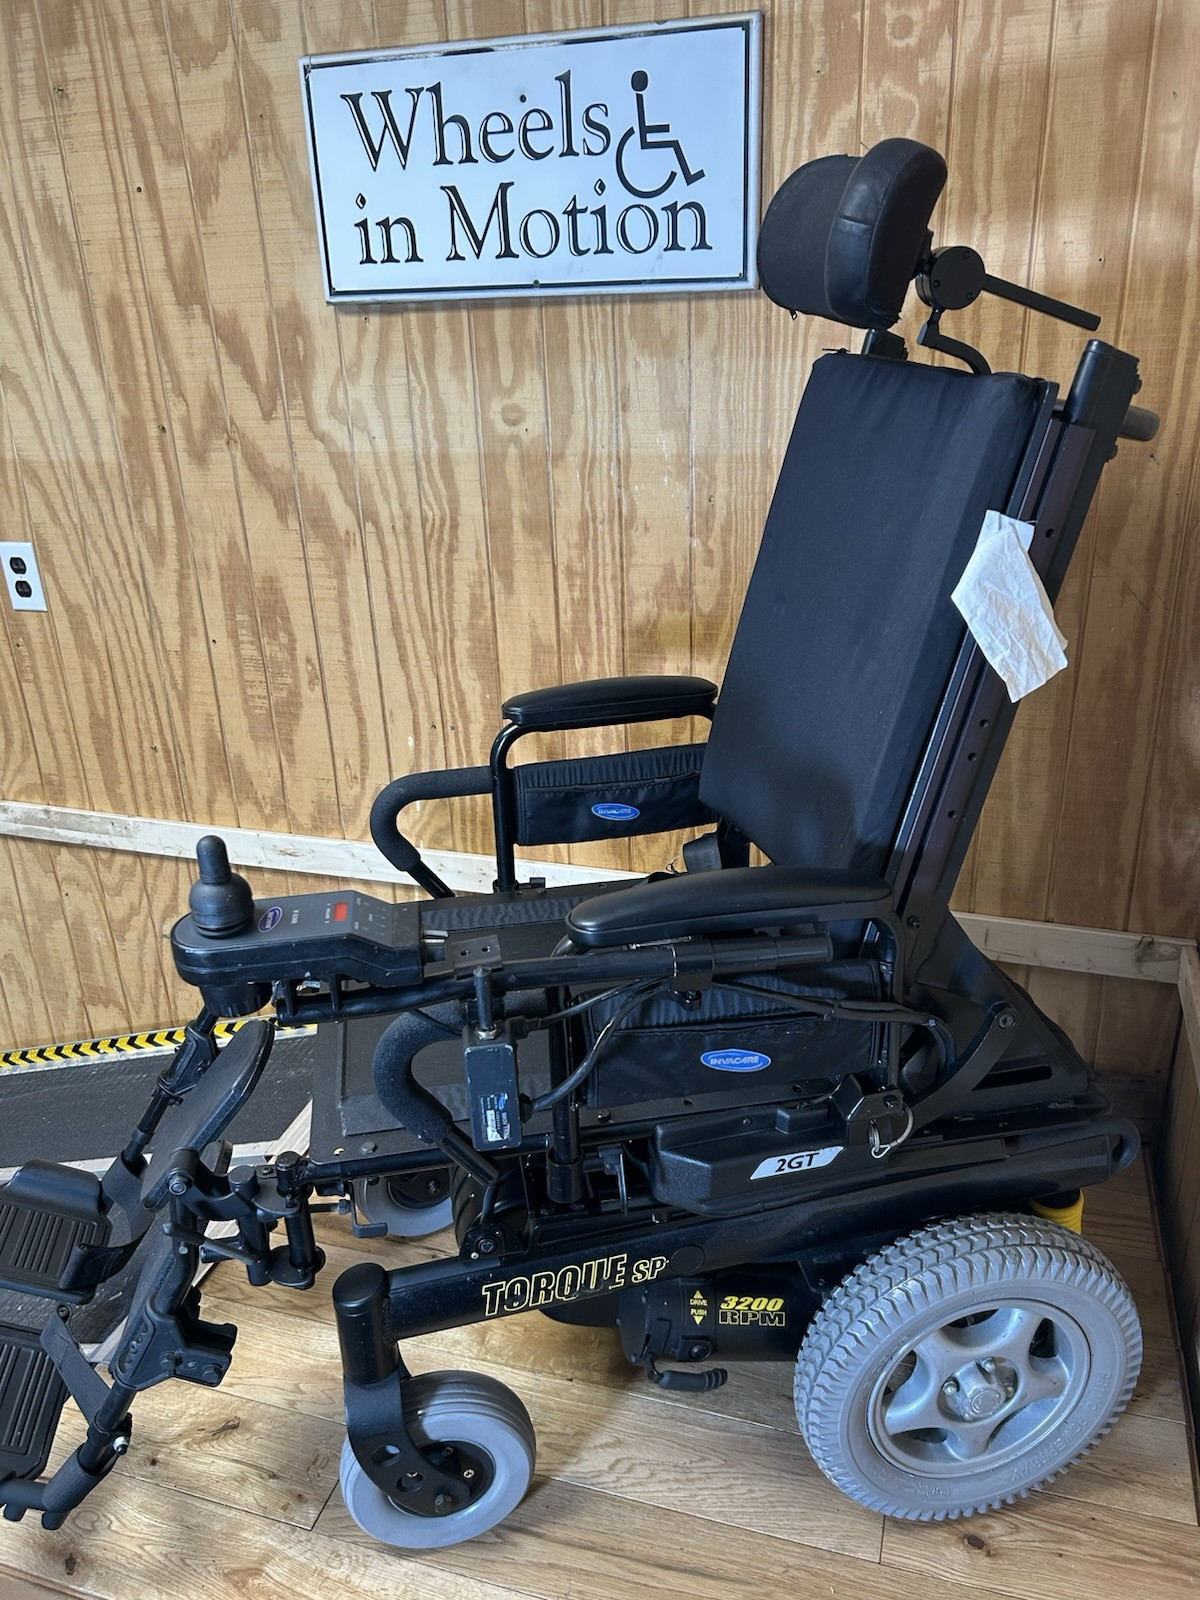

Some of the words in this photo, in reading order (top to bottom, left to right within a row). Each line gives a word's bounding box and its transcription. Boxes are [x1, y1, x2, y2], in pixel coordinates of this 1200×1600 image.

[340, 69, 611, 172] Wheels
[353, 192, 424, 265] in
[440, 178, 713, 260] Motion
[710, 1055, 760, 1066] INVACARE
[775, 1152, 820, 1173] 2GT
[482, 1253, 627, 1317] TORQUE
[632, 1256, 667, 1284] SP
[689, 1298, 708, 1306] DRIVE
[720, 1295, 785, 1311] 3200
[690, 1308, 708, 1316] PUSH
[718, 1309, 786, 1327] RPM
